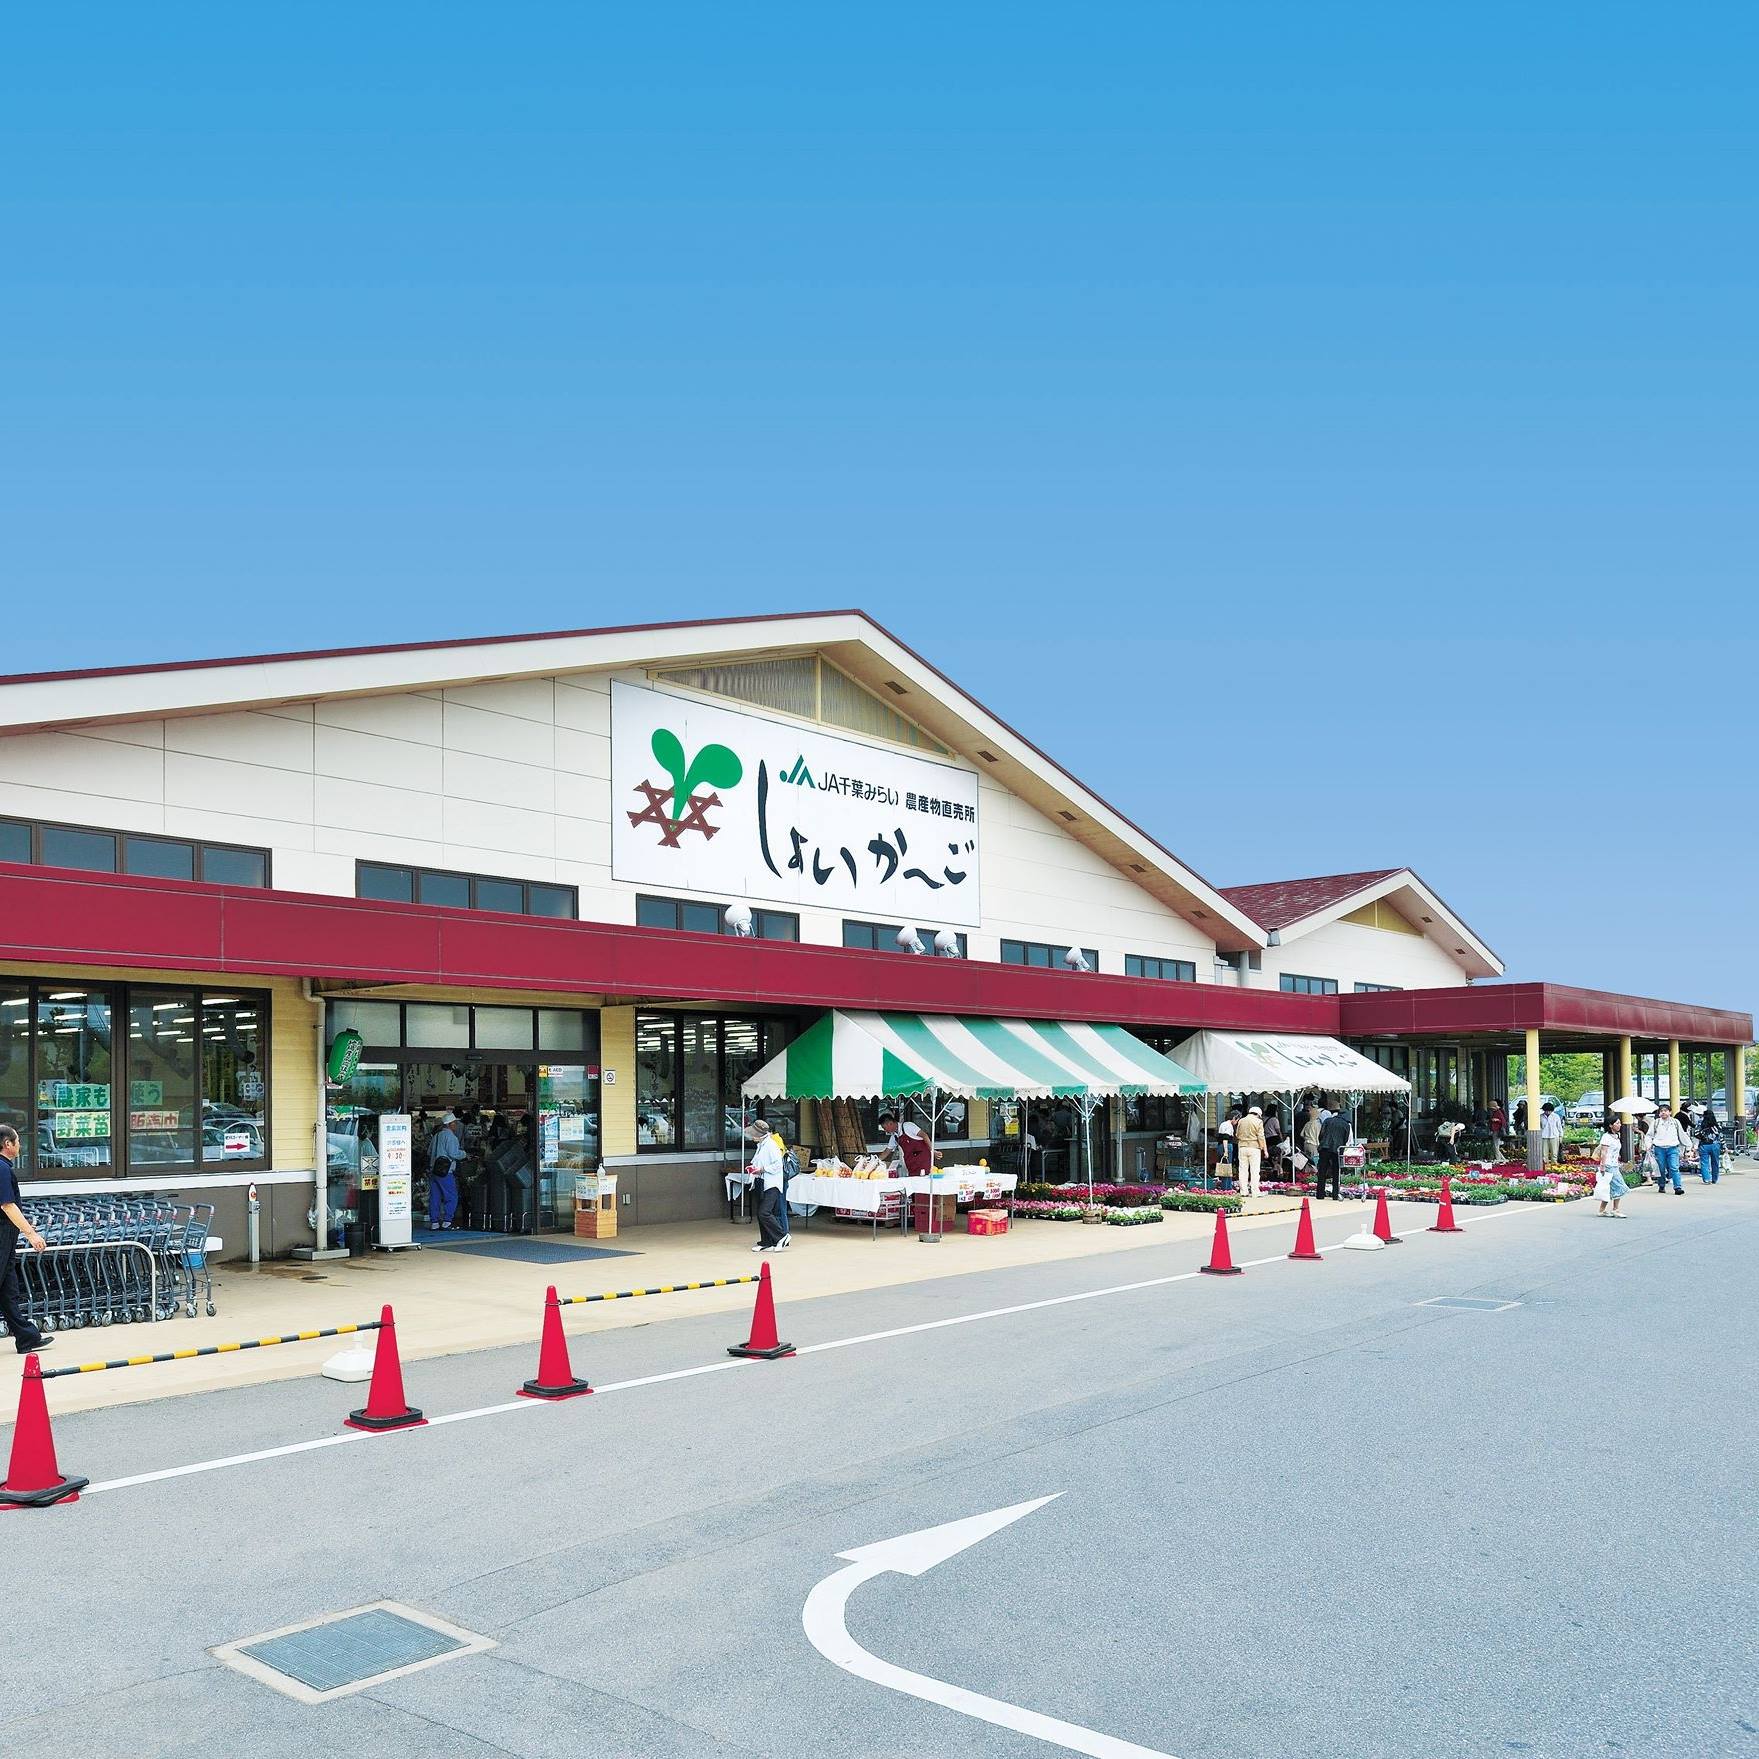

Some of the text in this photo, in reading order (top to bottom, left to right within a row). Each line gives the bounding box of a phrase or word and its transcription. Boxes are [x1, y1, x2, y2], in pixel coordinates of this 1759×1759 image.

[818, 771, 976, 824] JA千葉みらい 農産物直売所
